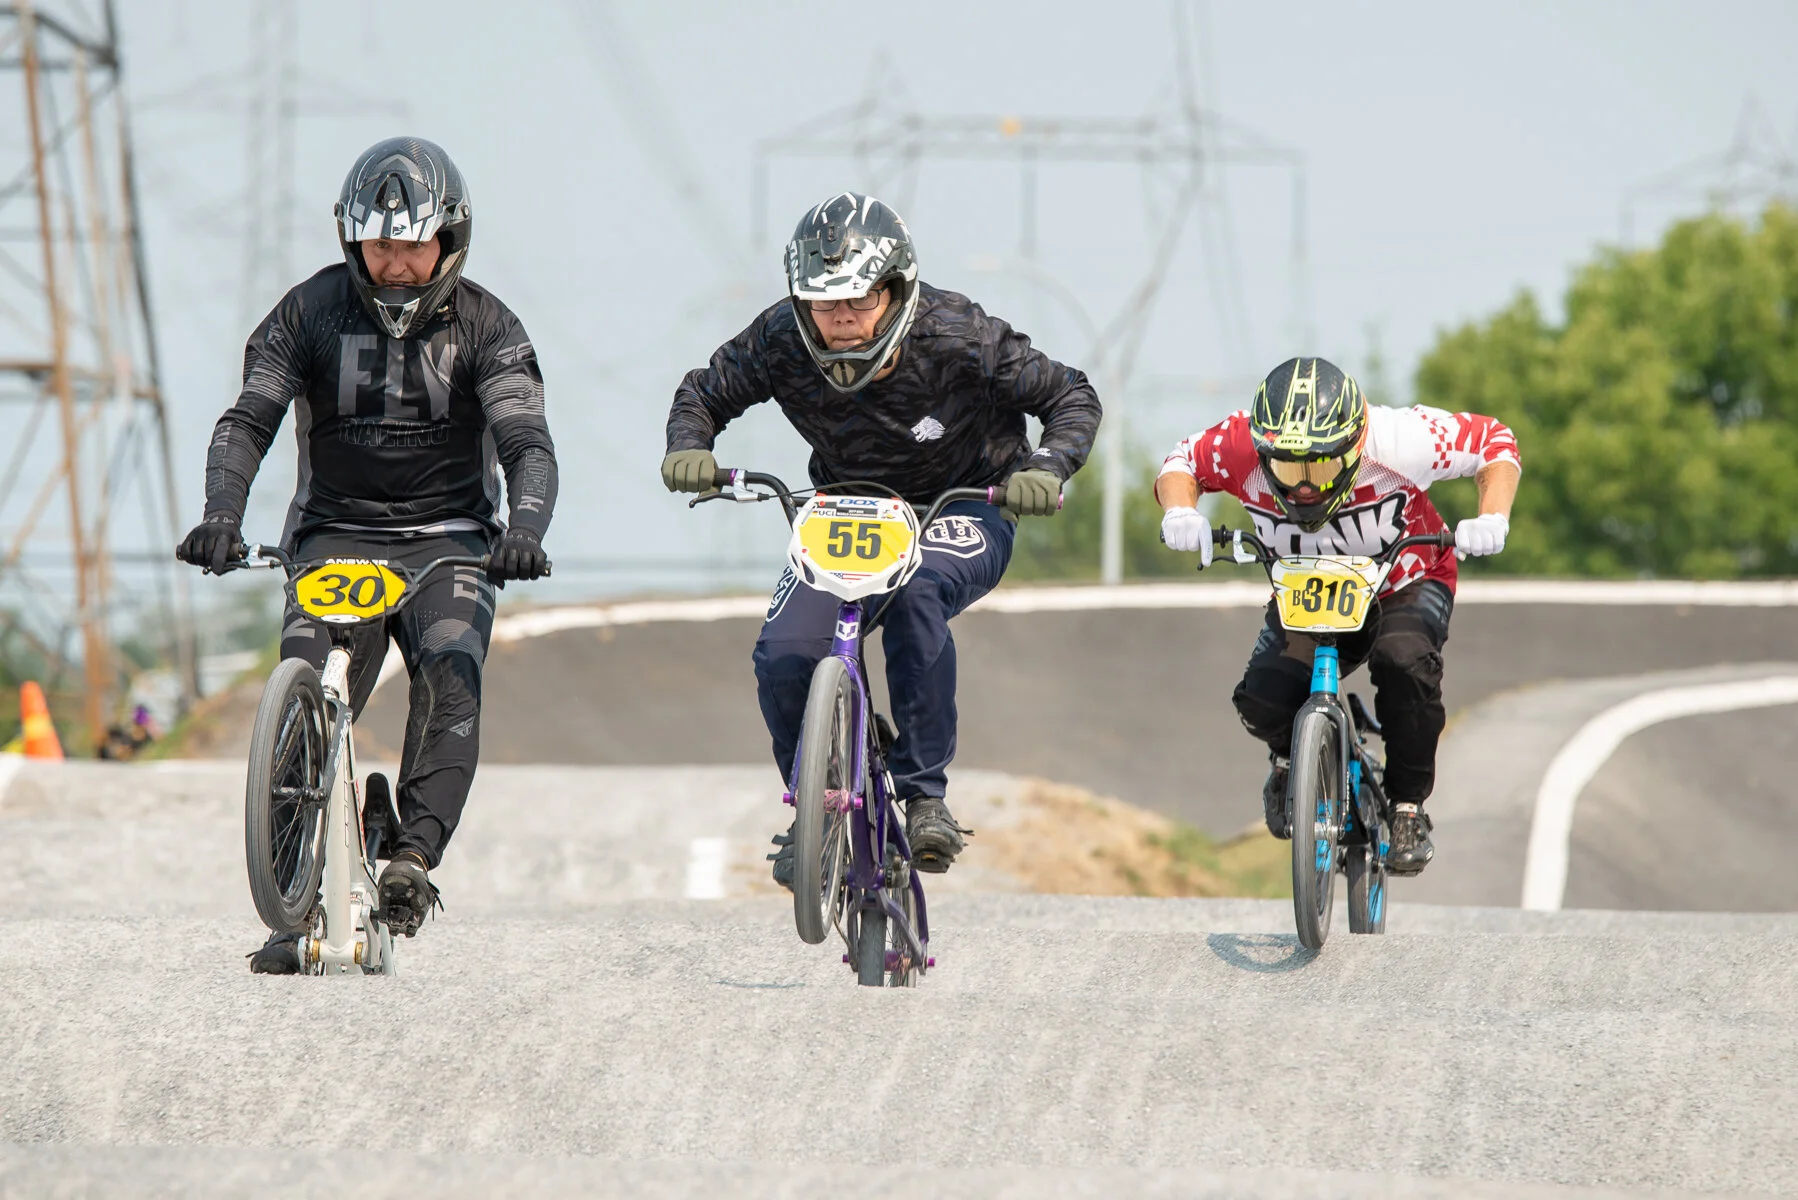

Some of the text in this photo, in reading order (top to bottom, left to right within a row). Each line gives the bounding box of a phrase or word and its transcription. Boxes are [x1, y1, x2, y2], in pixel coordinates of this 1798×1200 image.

[337, 334, 458, 420] FLY
[838, 498, 879, 507] BOX
[827, 521, 882, 560] 55
[310, 574, 385, 608] 30
[1302, 577, 1358, 617] 316
